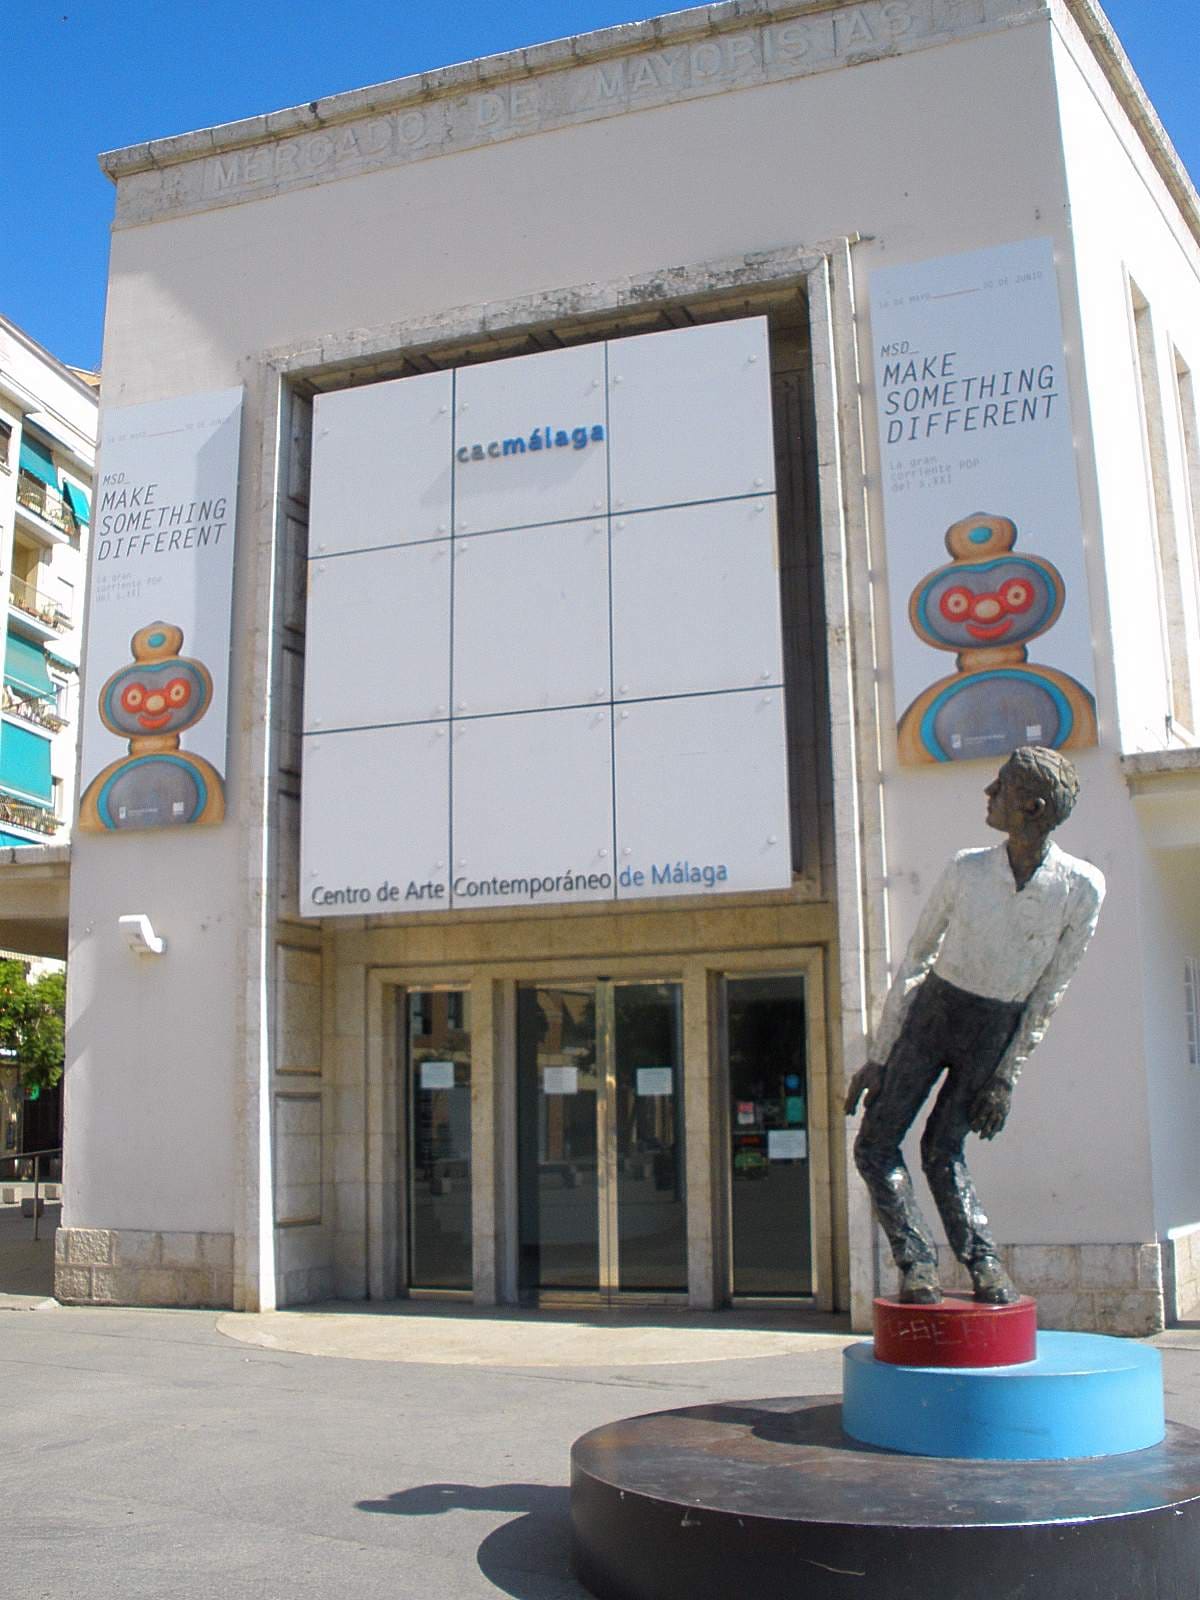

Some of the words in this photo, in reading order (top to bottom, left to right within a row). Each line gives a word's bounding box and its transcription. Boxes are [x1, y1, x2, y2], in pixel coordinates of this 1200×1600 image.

[214, 110, 427, 192] MERCADO
[477, 84, 540, 128] DE
[597, 2, 915, 99] MAYORISTAS
[883, 352, 957, 388] MAKE
[885, 364, 1054, 416] SOMETHING
[887, 393, 1059, 444] DIFFERENT
[457, 424, 604, 463] cacmálaga
[101, 483, 158, 512] MAKE
[100, 498, 227, 537] SOMETHING
[98, 522, 227, 561] DIFFERENT
[311, 886, 371, 906] Centro
[376, 881, 400, 902] de
[405, 880, 445, 900] Arte
[453, 869, 612, 899] Contemporáneo
[619, 865, 645, 888] de
[651, 861, 728, 888] Málaga
